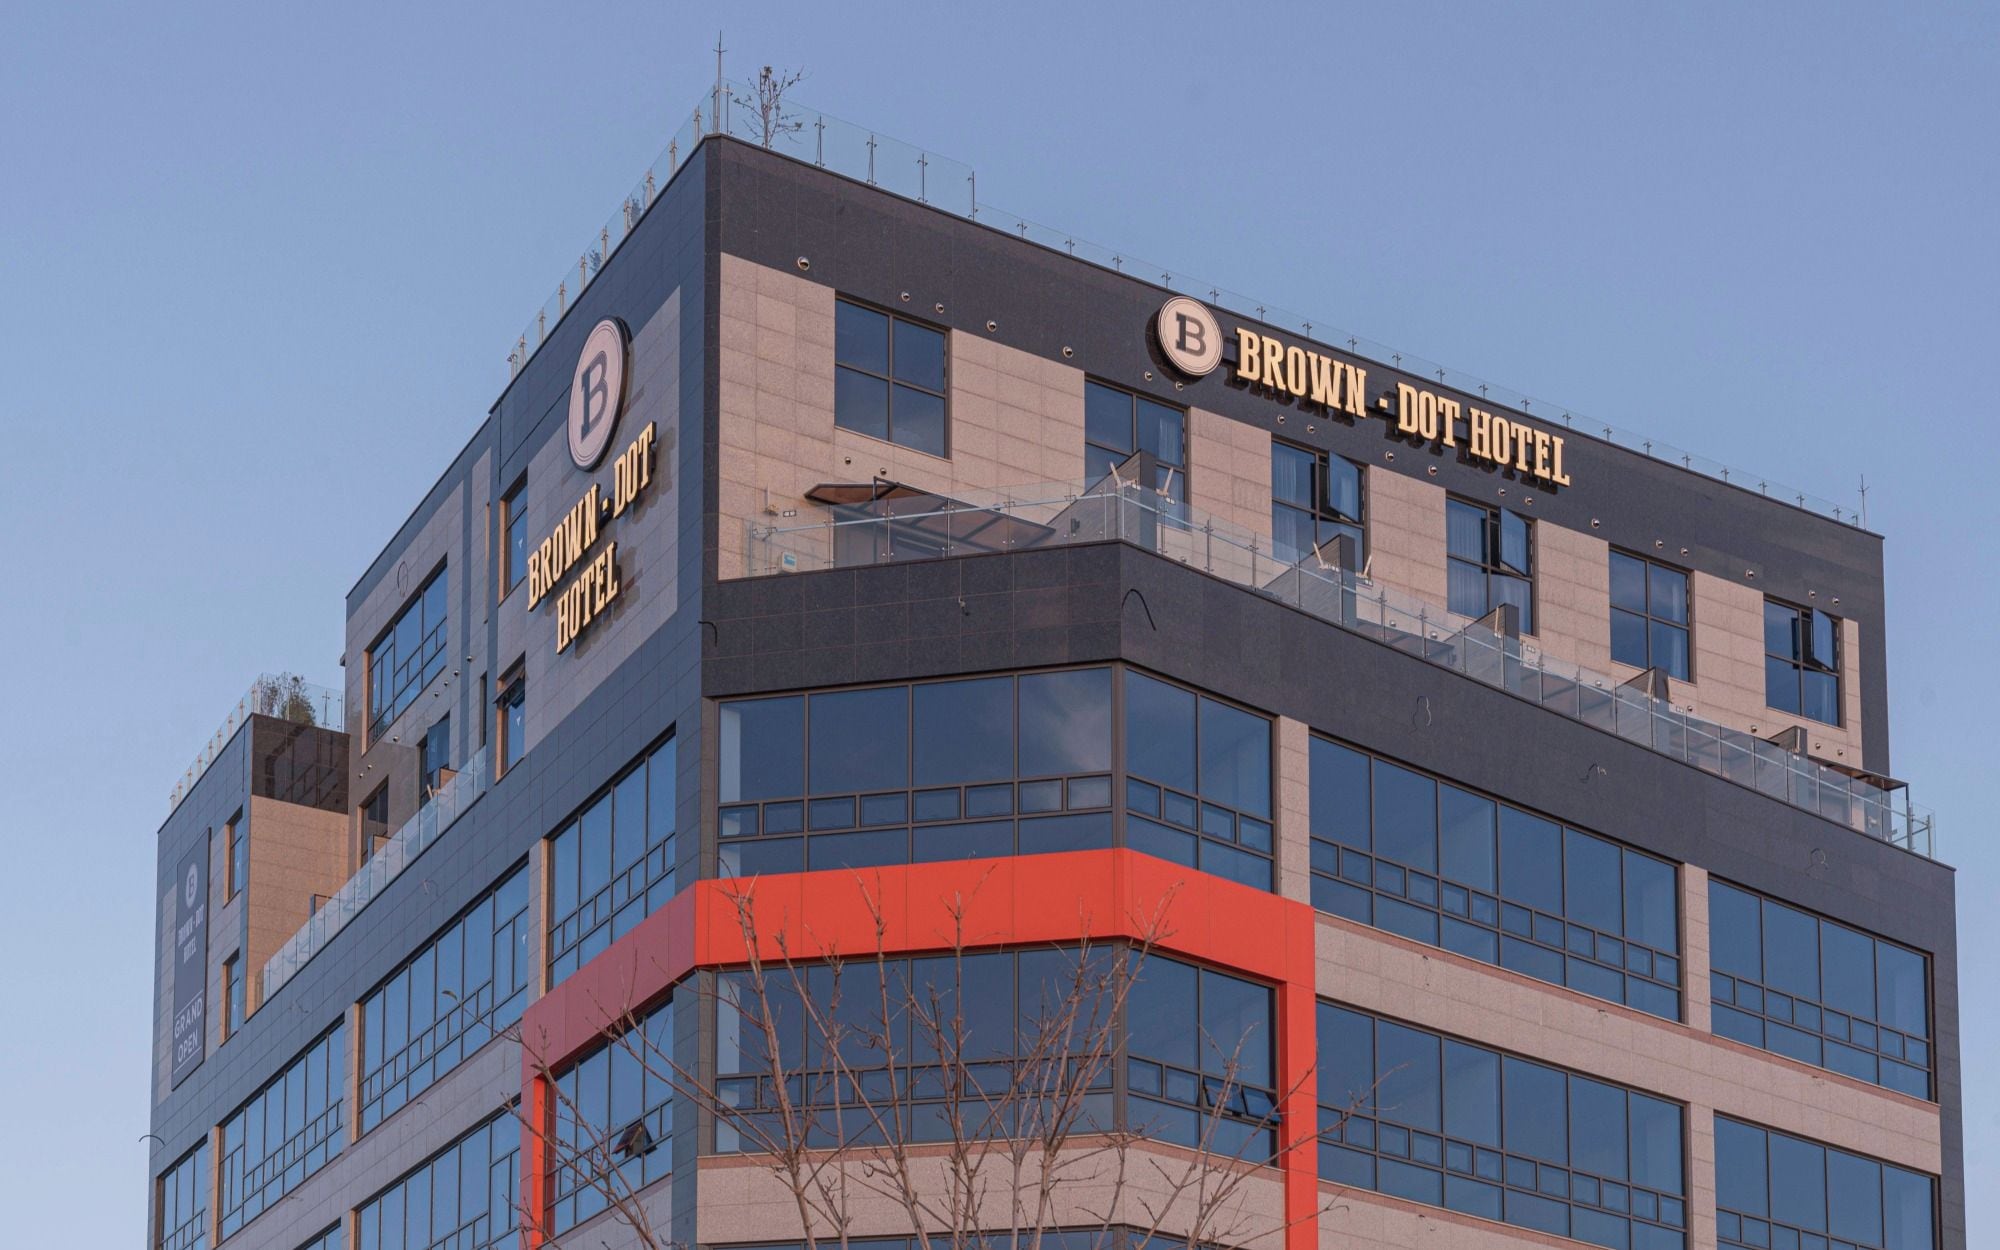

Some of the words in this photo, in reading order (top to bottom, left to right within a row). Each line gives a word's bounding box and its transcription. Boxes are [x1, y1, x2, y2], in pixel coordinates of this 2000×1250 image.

[1174, 311, 1207, 357] B
[580, 350, 609, 444] B
[1235, 327, 1367, 419] BROWN
[1397, 381, 1461, 448] DOT
[1469, 406, 1571, 487] HOTEL
[527, 483, 601, 612] BROWN
[613, 421, 656, 519] DOT
[556, 541, 618, 654] HOTEL
[174, 998, 203, 1039] GRAND
[178, 1028, 198, 1062] OPEN
